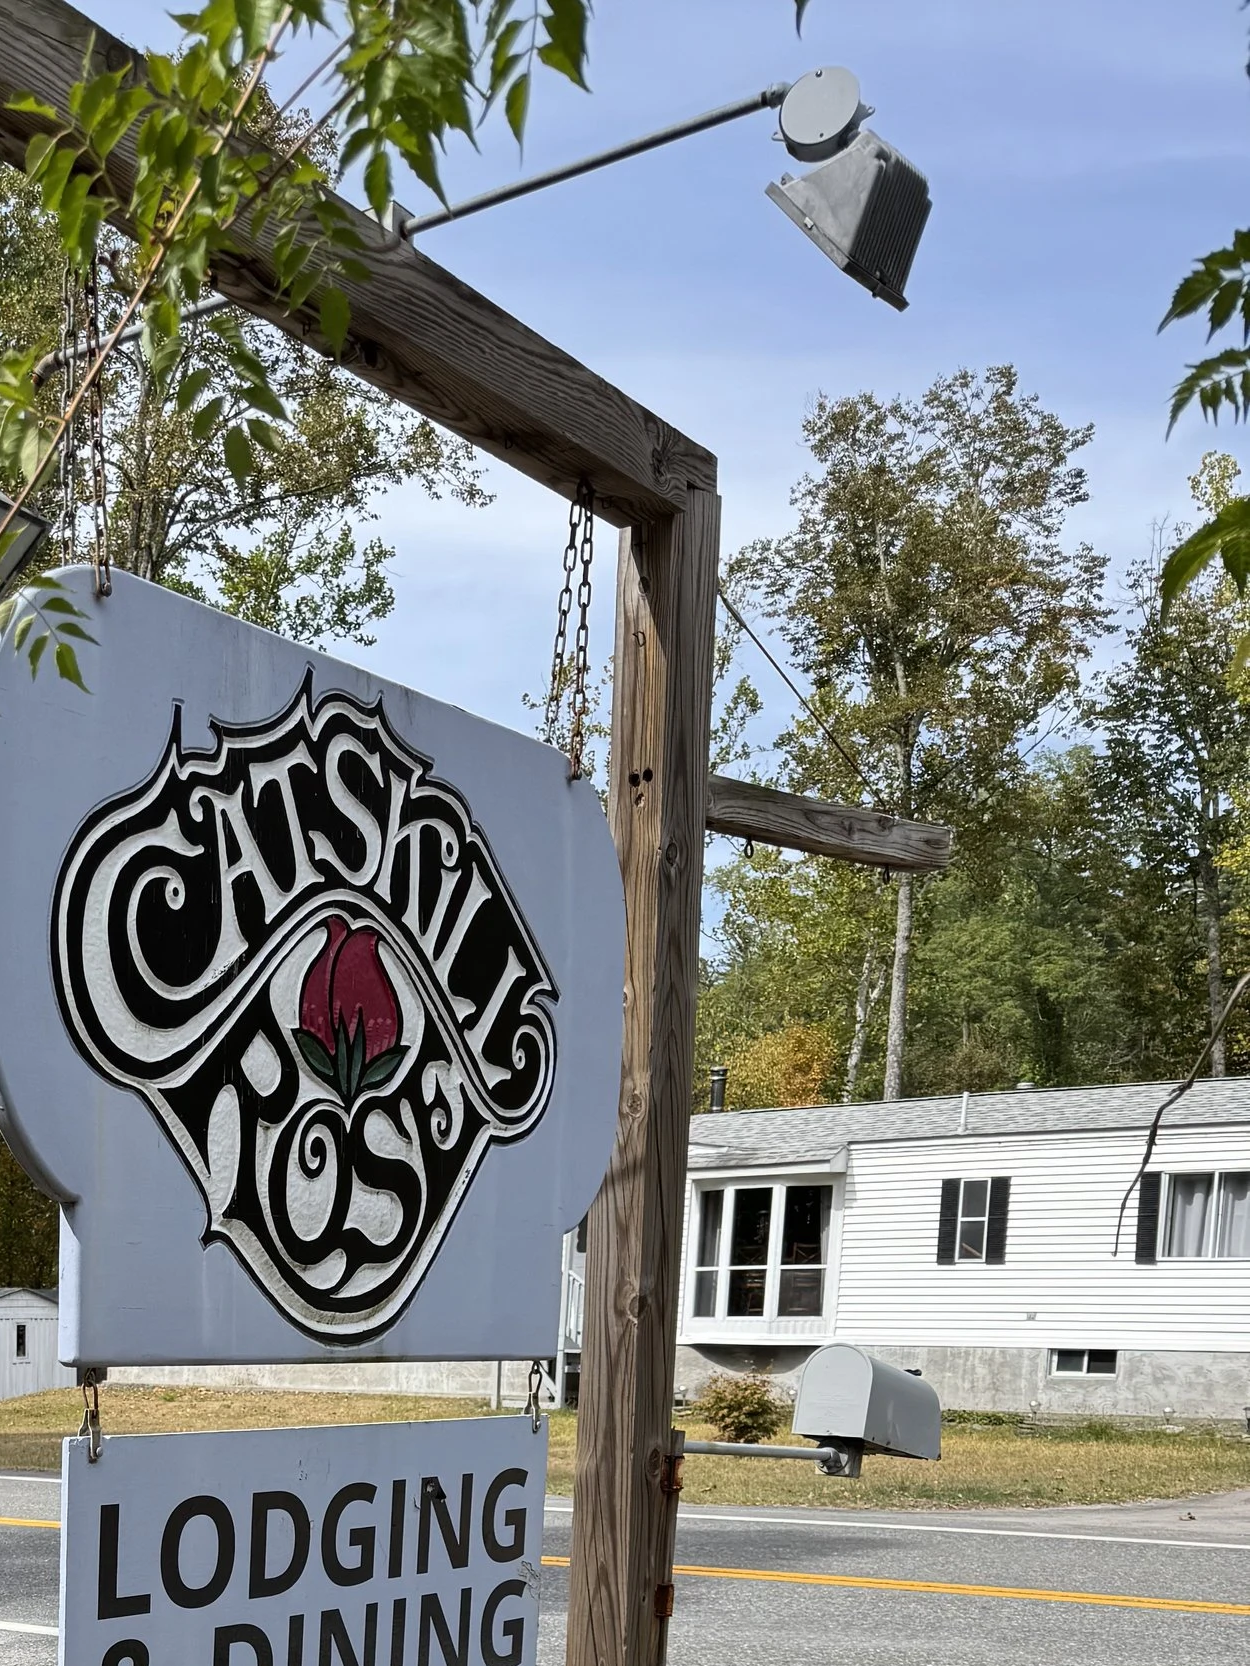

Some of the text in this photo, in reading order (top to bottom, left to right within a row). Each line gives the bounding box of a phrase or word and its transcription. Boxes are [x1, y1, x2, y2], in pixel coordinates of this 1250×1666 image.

[81, 731, 538, 1082] CATSKILL
[155, 1022, 487, 1299] ROSE
[97, 1467, 529, 1621] LODGING
